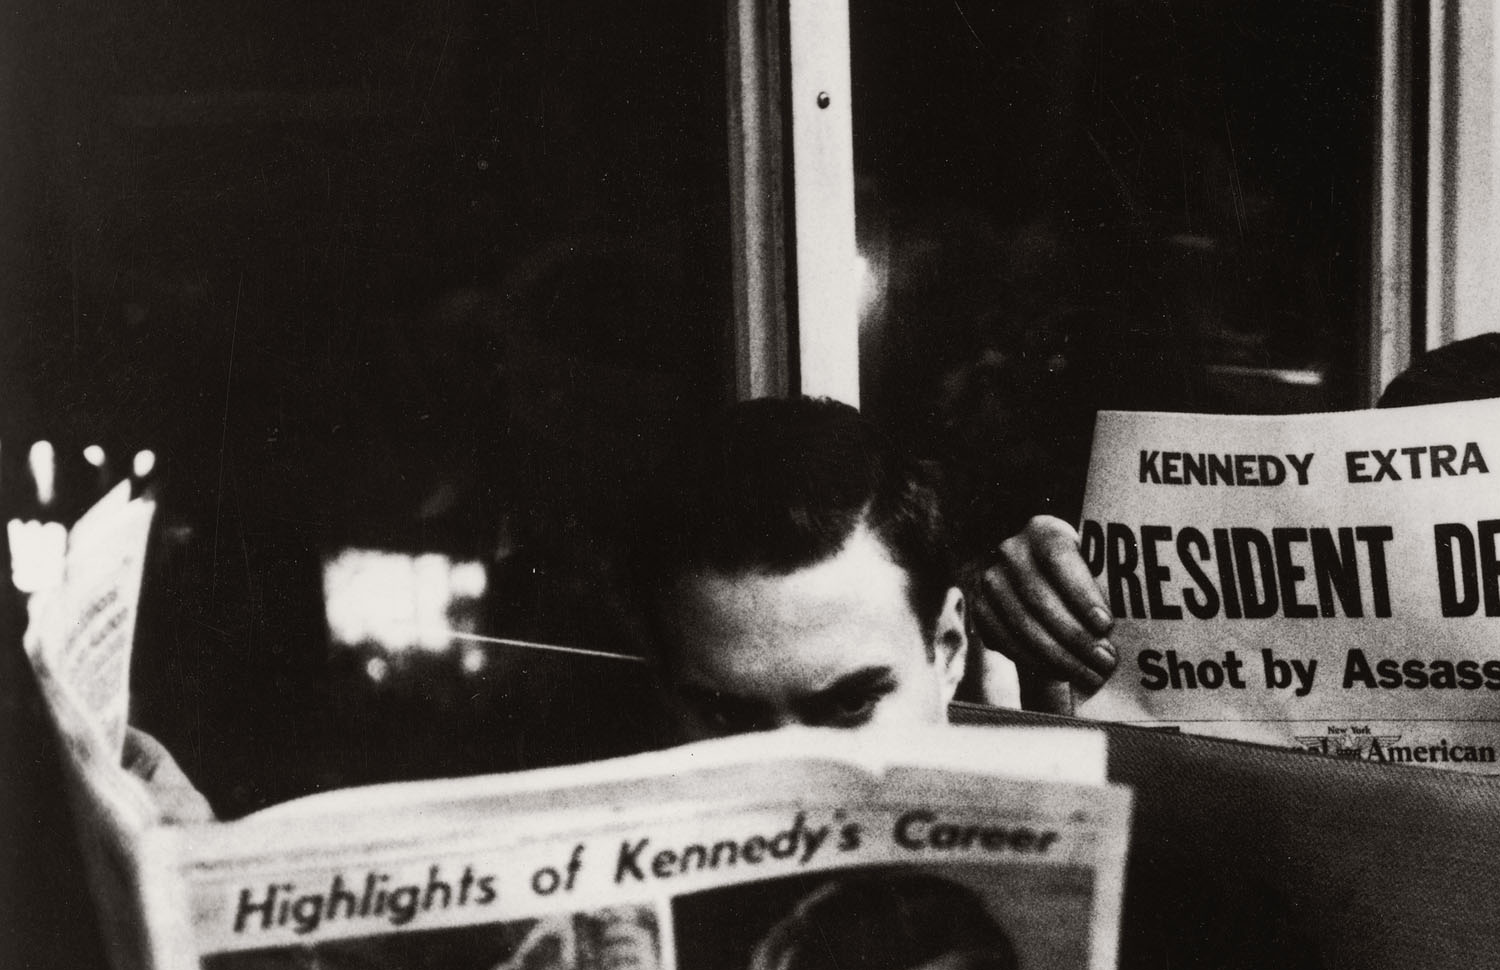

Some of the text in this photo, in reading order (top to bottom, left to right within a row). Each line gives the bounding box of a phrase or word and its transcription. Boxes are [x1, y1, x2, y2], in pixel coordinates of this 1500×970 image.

[1139, 441, 1490, 487] KENNEDY EXTRA
[1081, 519, 1394, 620] PRESIDENT
[1139, 648, 1246, 691] Shot
[1261, 648, 1318, 697] by
[1368, 738, 1497, 765] American
[233, 808, 1062, 935] Highlights of Kennedy's Career
